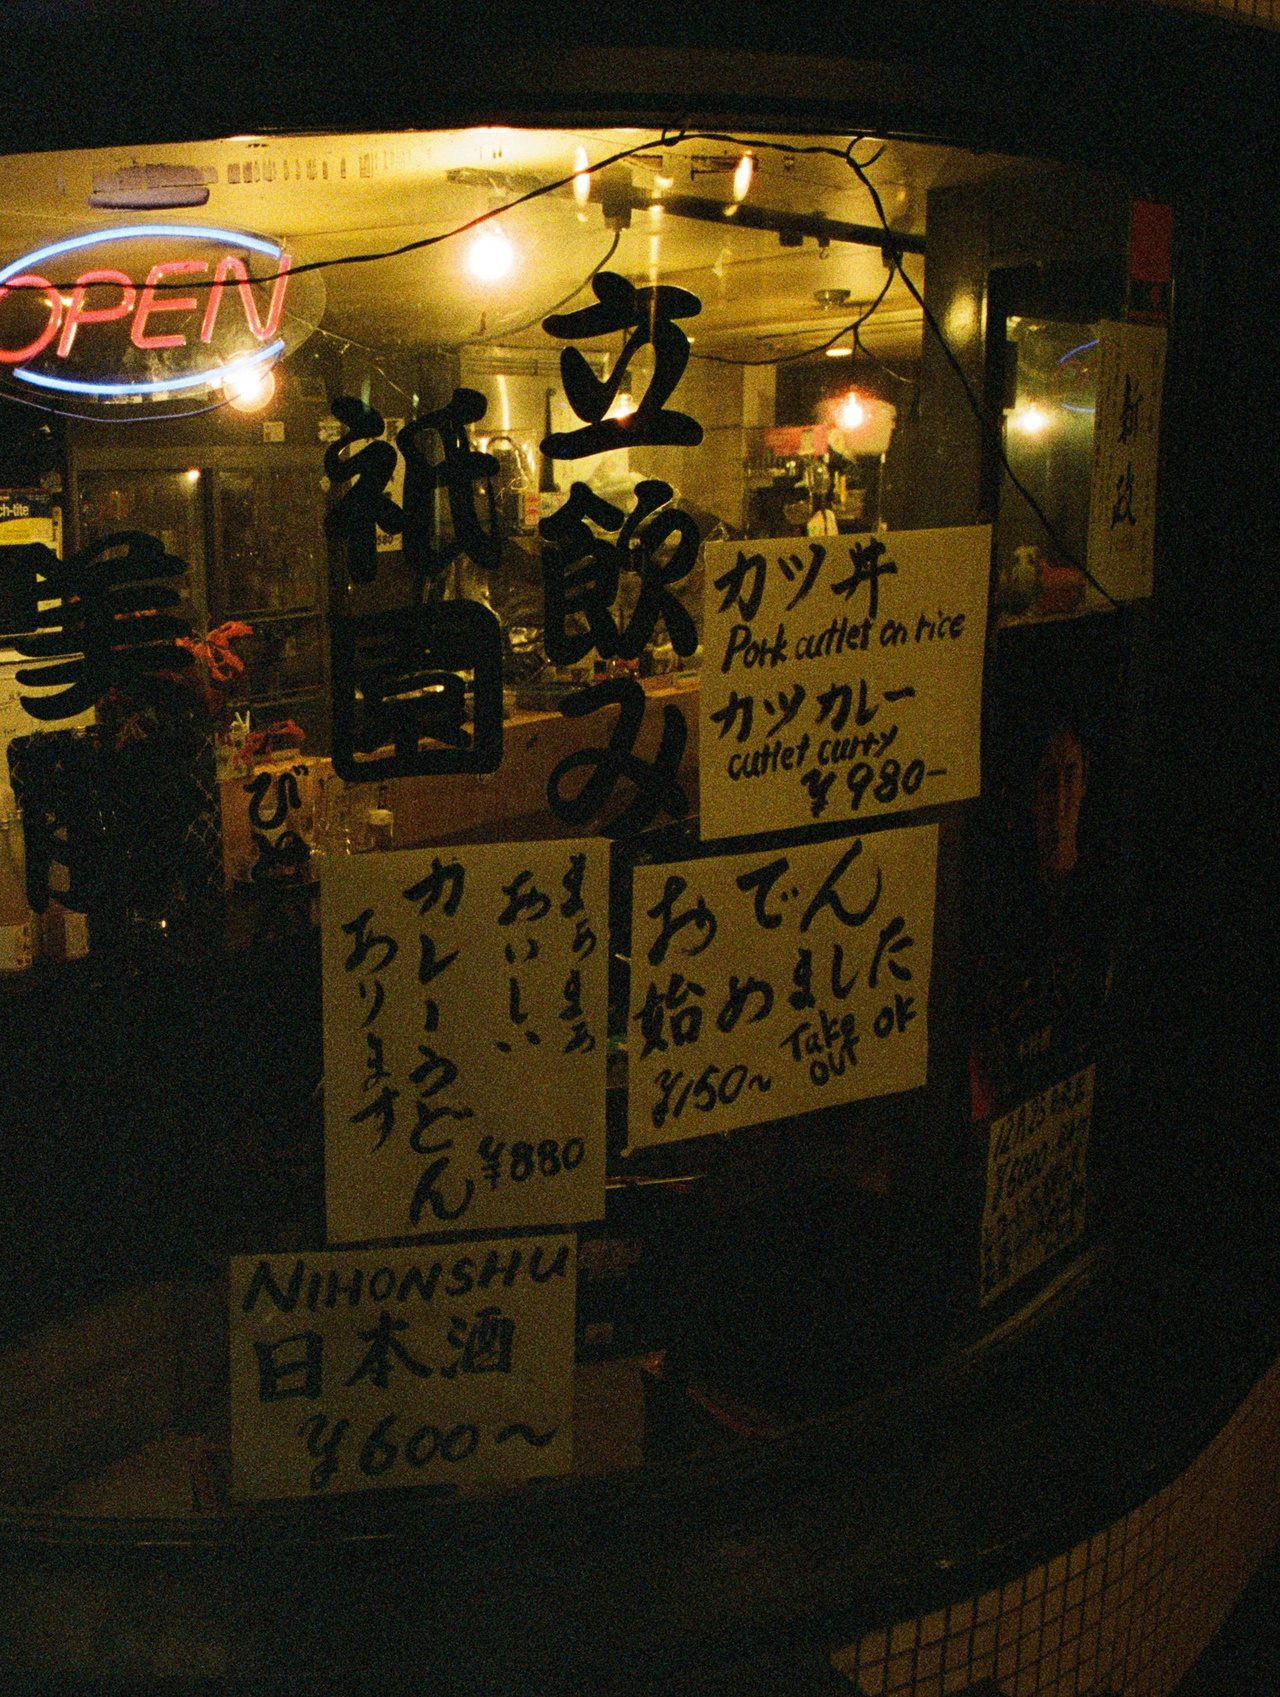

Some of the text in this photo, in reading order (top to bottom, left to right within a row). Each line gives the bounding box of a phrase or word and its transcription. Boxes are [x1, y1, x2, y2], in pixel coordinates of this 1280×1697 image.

[720, 609, 966, 674] Pork cutlet on rice
[709, 678, 917, 743] カツカレー
[727, 724, 899, 782] cutlet curry
[646, 838, 883, 967] おでん
[340, 908, 401, 1154] あります
[402, 856, 475, 1227] カレーうどん
[779, 1009, 857, 1062] Take
[478, 1134, 586, 1192] ¥880
[242, 1246, 569, 1314] NIHONSHU
[253, 1306, 517, 1401] 日本酒
